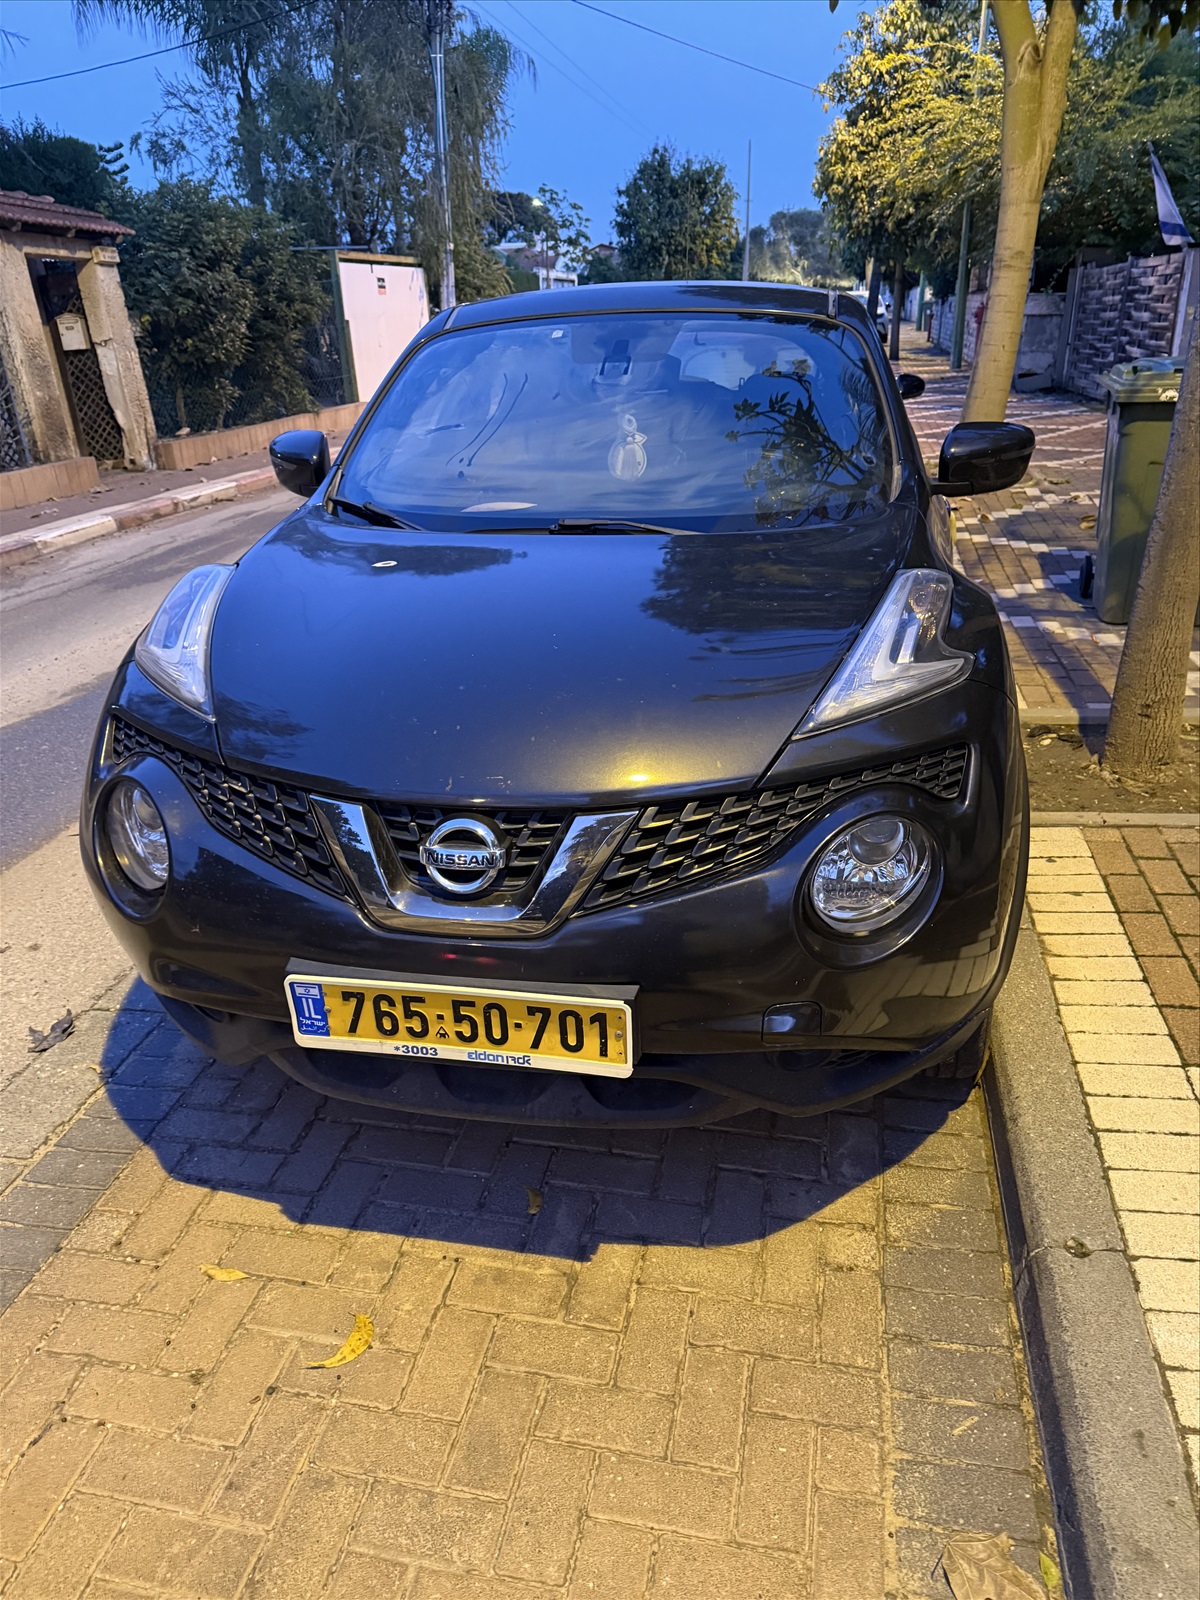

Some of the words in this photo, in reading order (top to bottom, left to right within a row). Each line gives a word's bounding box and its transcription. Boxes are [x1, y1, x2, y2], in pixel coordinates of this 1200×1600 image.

[427, 851, 495, 866] NISSAN
[301, 997, 322, 1019] IL
[300, 1017, 325, 1026] ישראל
[341, 991, 608, 1057] 765-50-701
[467, 1050, 504, 1063] eldan
